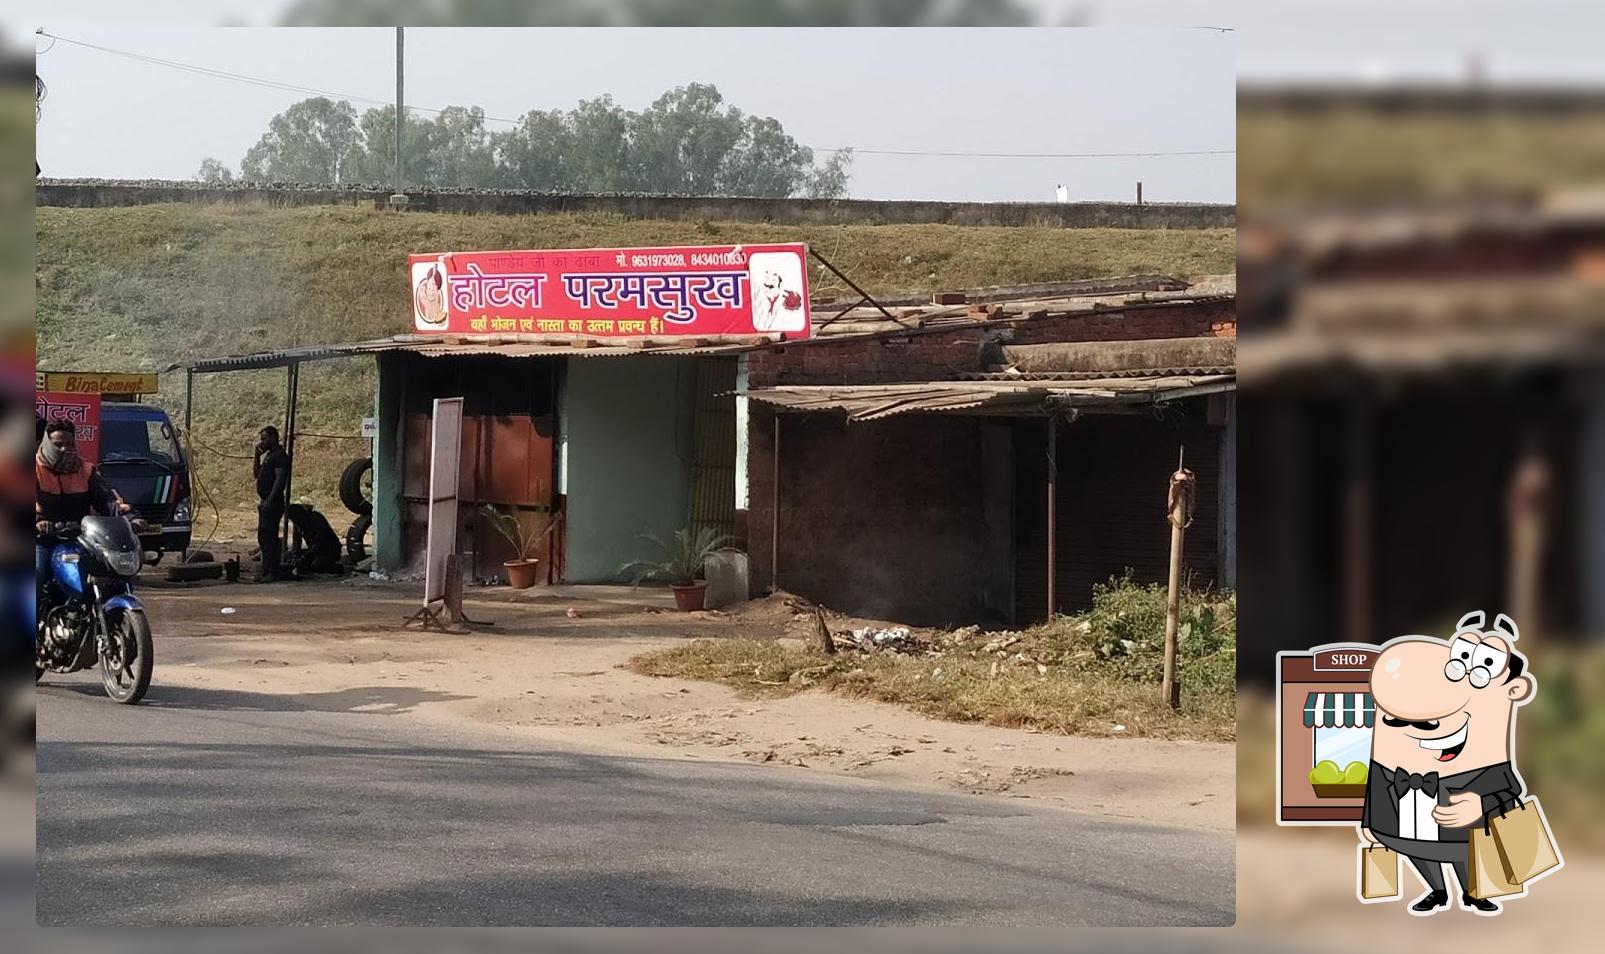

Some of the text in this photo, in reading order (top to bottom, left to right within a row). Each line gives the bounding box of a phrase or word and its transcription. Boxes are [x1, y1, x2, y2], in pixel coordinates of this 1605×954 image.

[530, 254, 545, 268] जी
[552, 256, 567, 267] का
[575, 255, 601, 269] ढाबा
[615, 250, 629, 267] मो.
[448, 263, 749, 324] होटल परमसुख
[491, 315, 517, 331] भोजन
[519, 316, 534, 331] एवं
[536, 319, 565, 332] नास्ता
[568, 319, 583, 332] का
